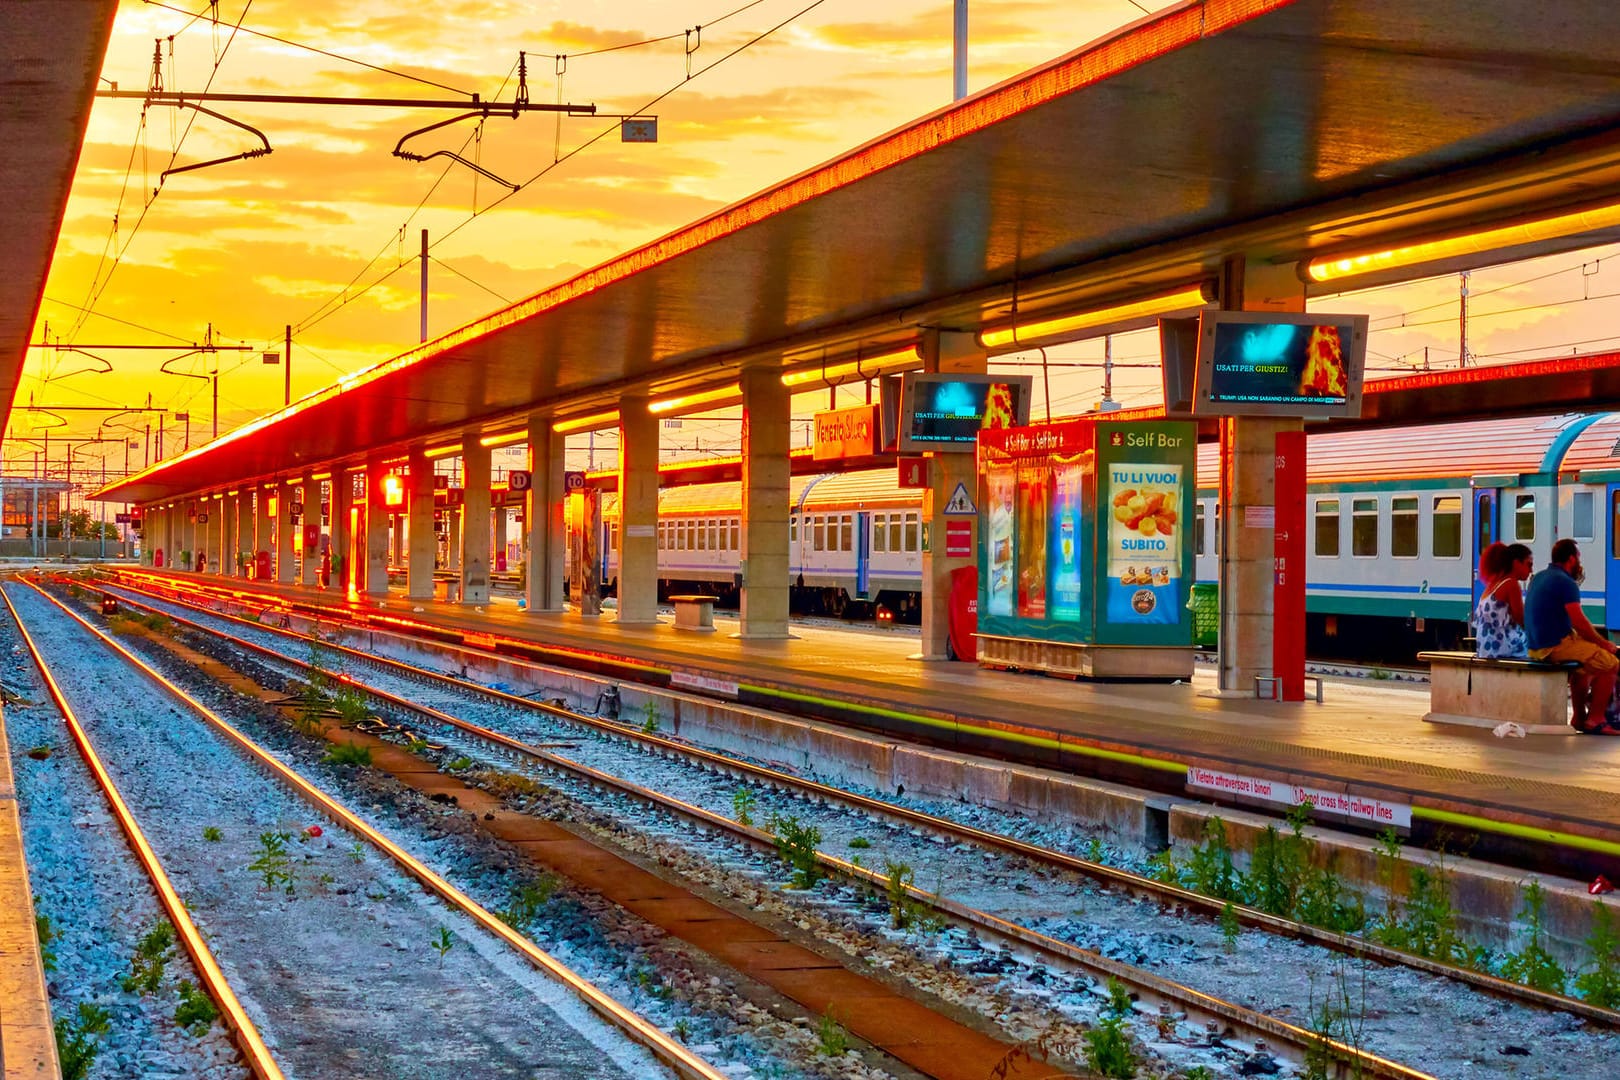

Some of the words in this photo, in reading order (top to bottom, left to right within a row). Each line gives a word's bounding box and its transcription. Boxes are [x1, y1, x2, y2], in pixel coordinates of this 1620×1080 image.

[1216, 364, 1238, 372] USATI
[1240, 364, 1254, 372] PER
[816, 416, 844, 443] Venezia
[1127, 432, 1155, 447] Self
[1158, 433, 1183, 448] Bar
[513, 476, 525, 486] 11
[570, 477, 582, 487] 10
[1112, 472, 1129, 484] TU
[1131, 472, 1143, 484] LI
[1421, 579, 1429, 594] 2
[1195, 768, 1214, 785] Vietato
[1215, 774, 1249, 792] attraversare
[1254, 778, 1272, 796] binari
[1320, 795, 1336, 809] cross
[1338, 794, 1349, 811] the
[1350, 799, 1375, 819] railway
[1376, 800, 1393, 820] lines
